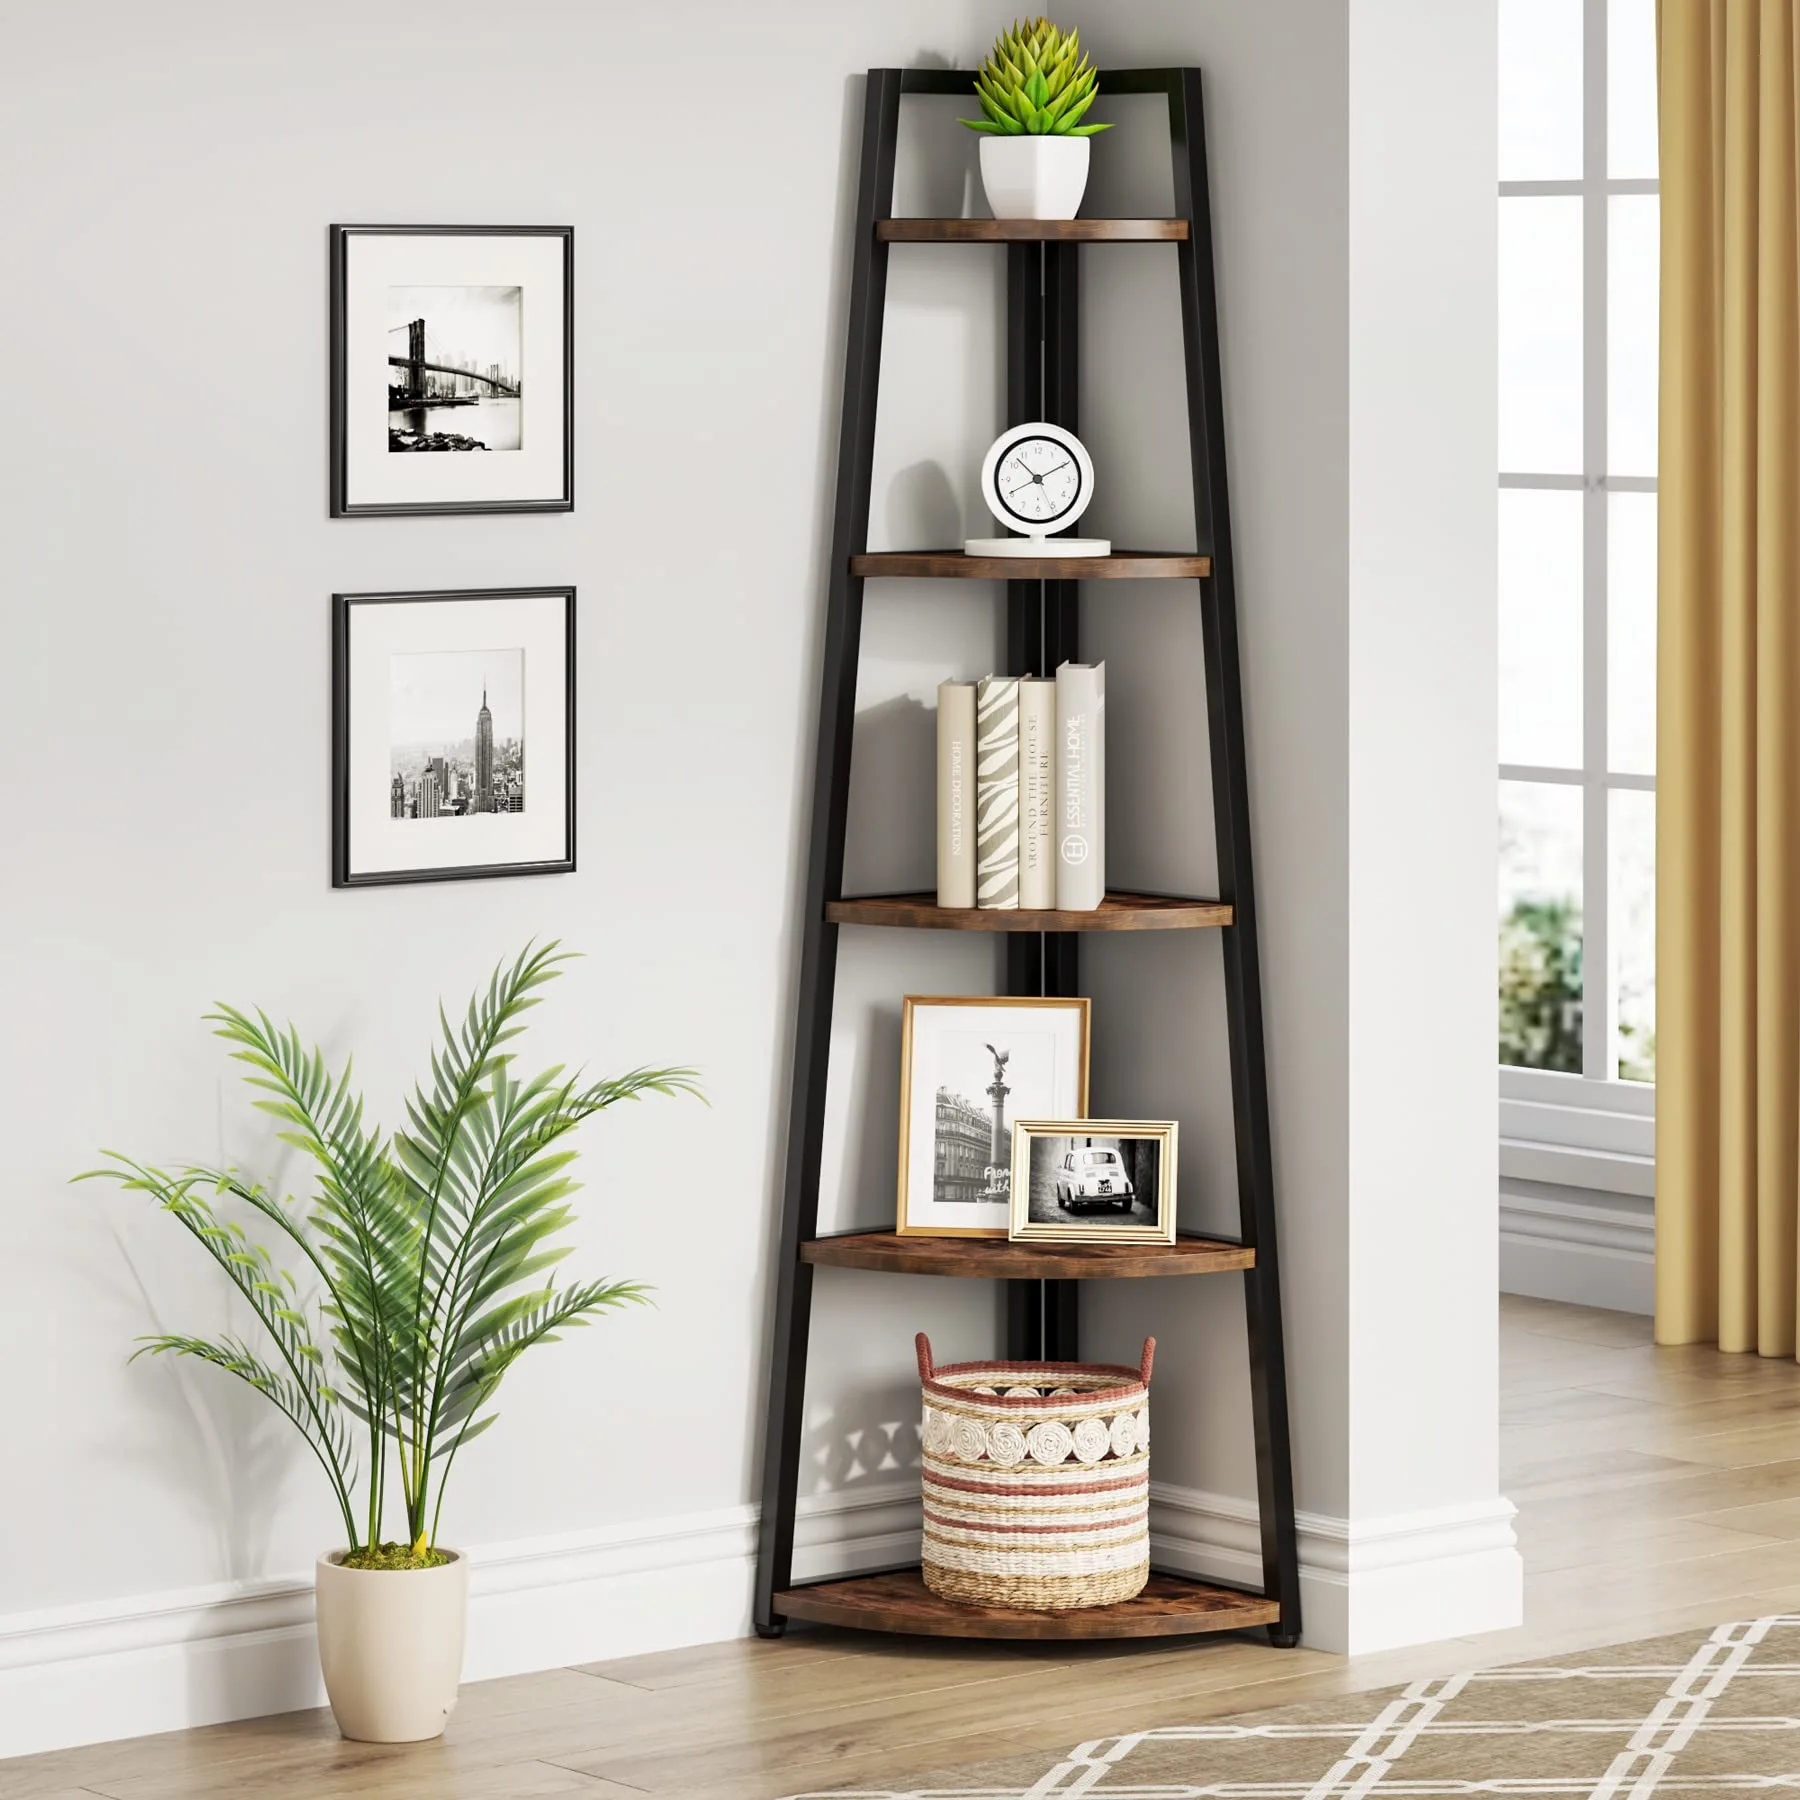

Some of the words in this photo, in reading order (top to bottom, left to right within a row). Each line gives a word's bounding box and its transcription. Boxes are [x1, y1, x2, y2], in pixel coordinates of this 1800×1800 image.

[1009, 461, 1019, 470] 10
[1020, 451, 1028, 459] 11
[1034, 446, 1043, 455] 12
[1066, 476, 1071, 484] 3
[1028, 715, 1037, 765] HOUSE
[1066, 714, 1080, 759] HOME
[951, 741, 962, 777] HOME
[1028, 772, 1037, 802] THE
[1040, 751, 1049, 837] FURNITURE
[1066, 760, 1080, 828] ESSENTIAL
[951, 779, 962, 856] DECORATION
[1028, 808, 1037, 869] AROUND
